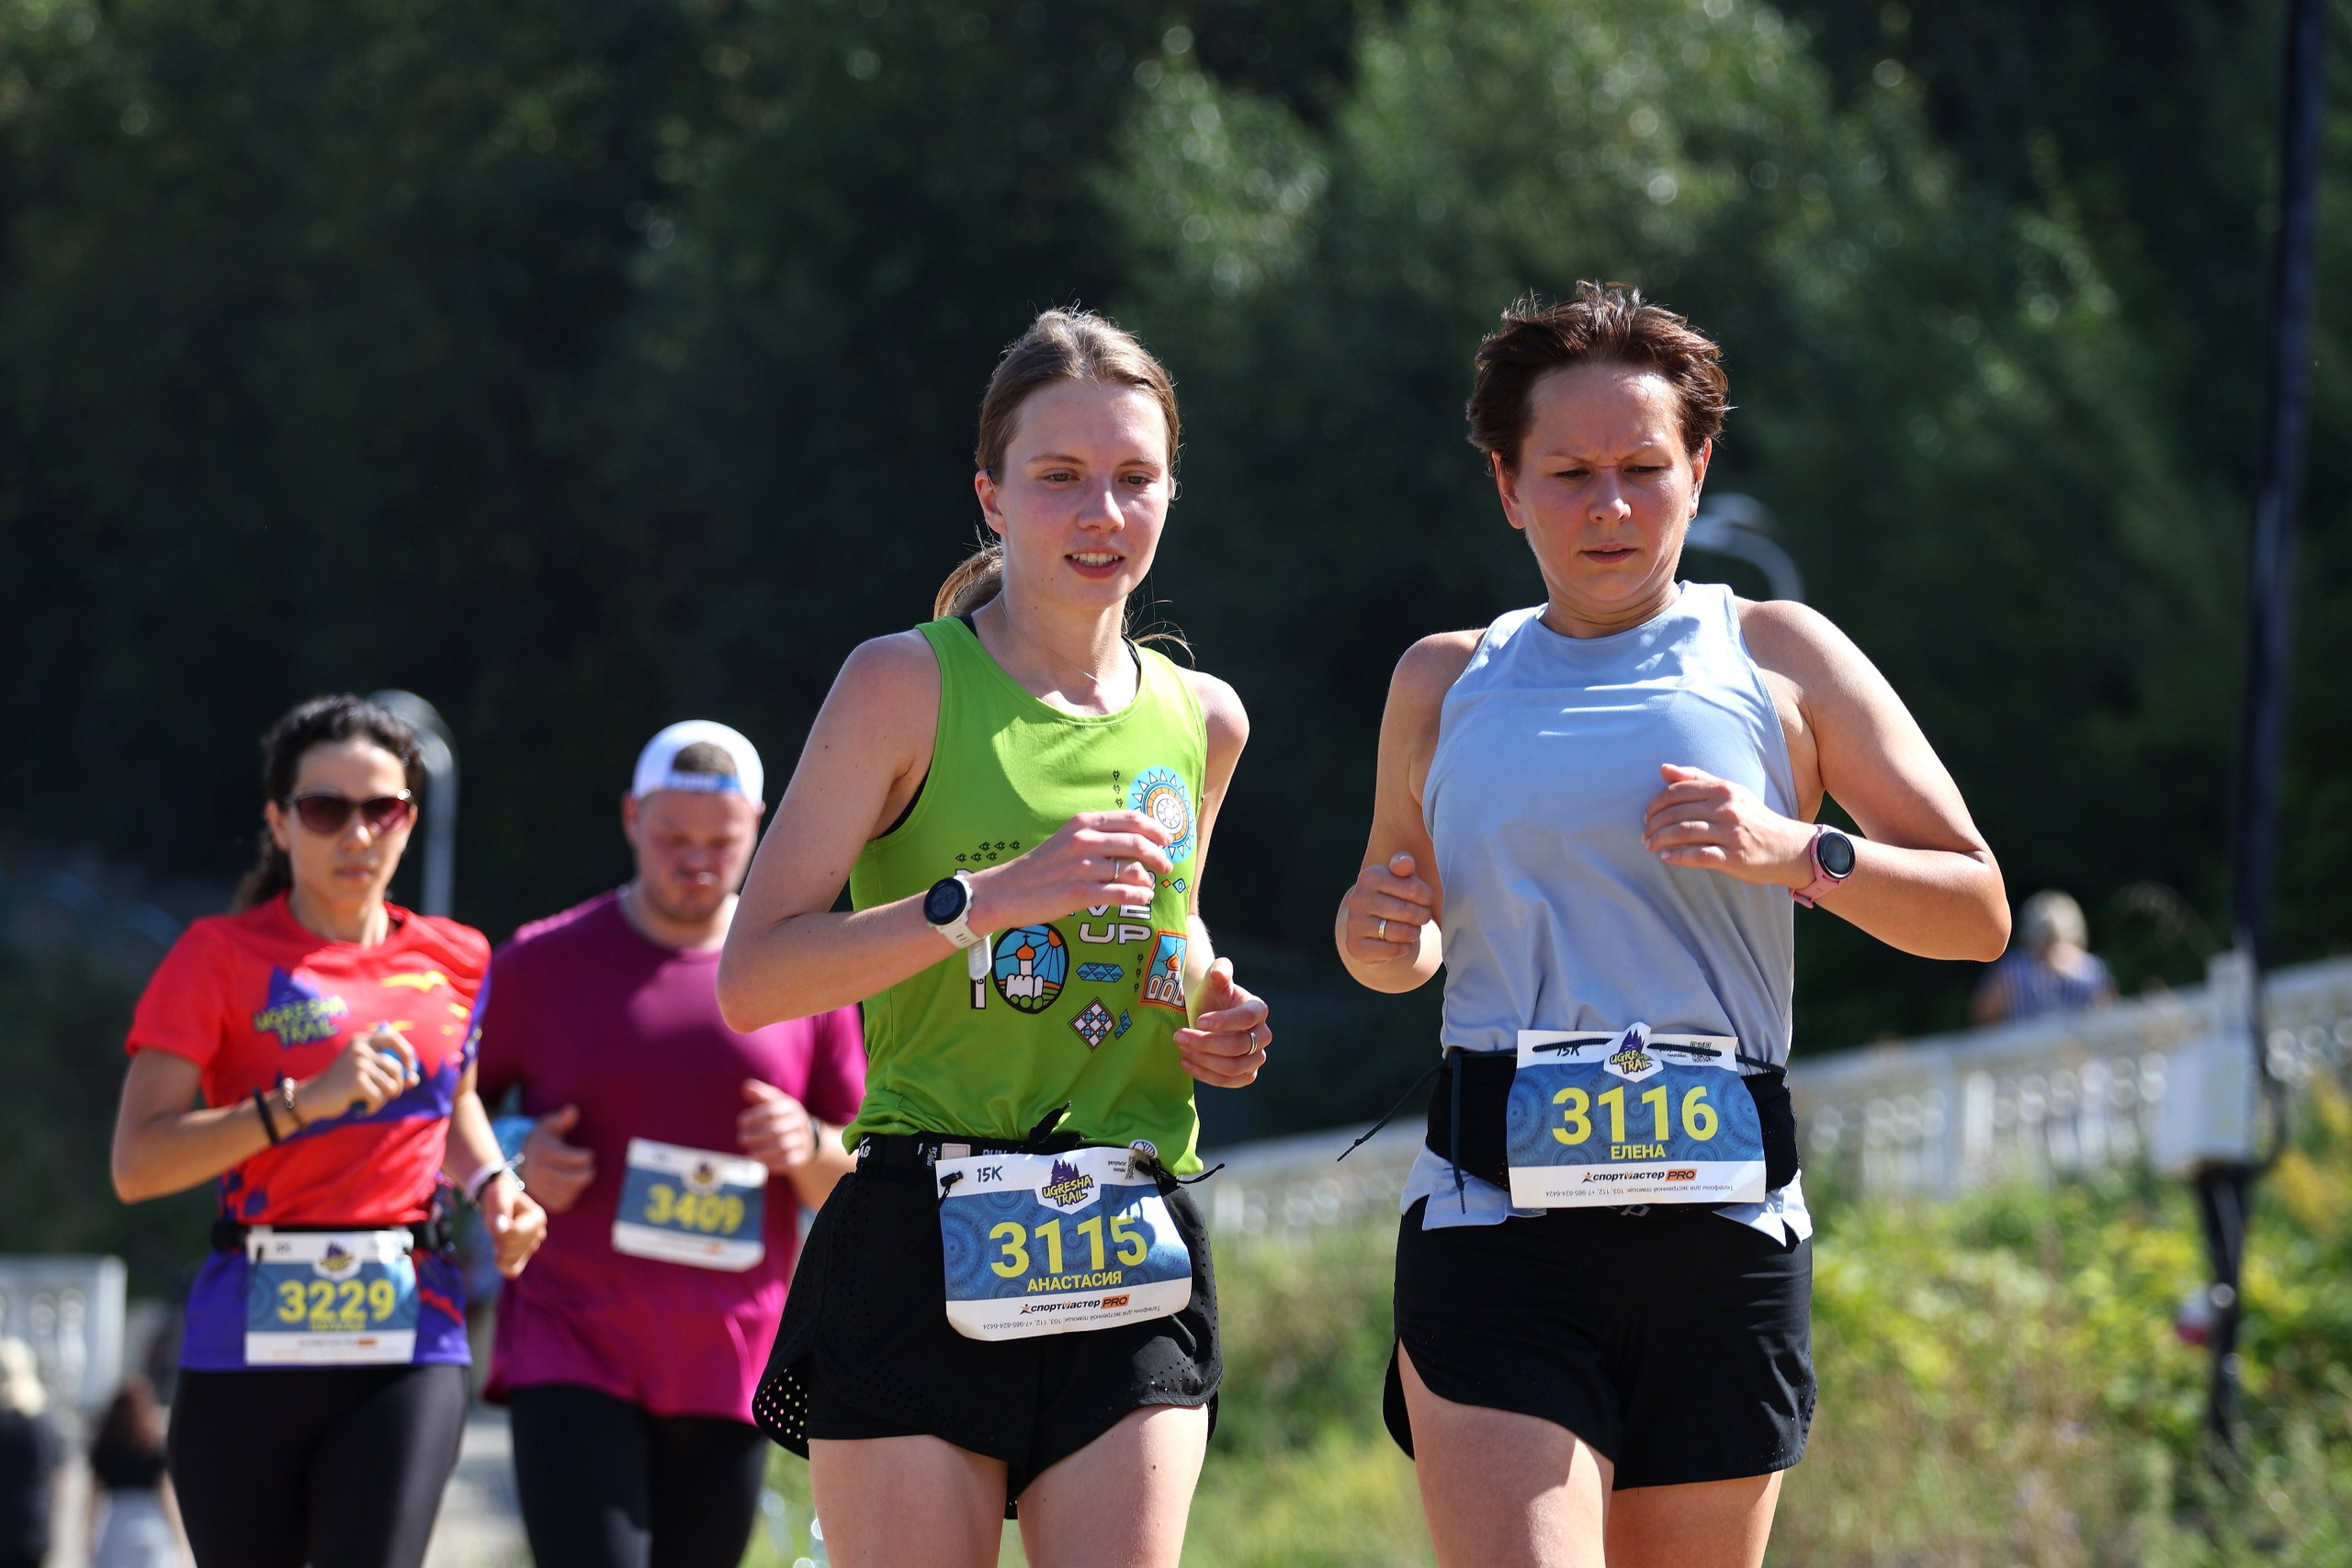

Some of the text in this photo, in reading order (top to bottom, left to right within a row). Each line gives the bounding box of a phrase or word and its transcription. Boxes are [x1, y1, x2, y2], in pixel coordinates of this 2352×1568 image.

[1078, 922, 1151, 945] UP
[1610, 1049, 1654, 1065] UGRE
[1620, 1060, 1653, 1075] TRAIL
[1552, 1085, 1718, 1146] 3116
[1611, 1144, 1666, 1160] ЕЛЕНА
[977, 1166, 1002, 1182] 15K
[1667, 1170, 1695, 1180] PRO
[1042, 1174, 1094, 1198] UGRESHA
[1054, 1190, 1089, 1207] TRAIL
[645, 1182, 745, 1235] 3409
[989, 1215, 1148, 1278] 3115
[1026, 1270, 1122, 1292] АНАСТАСИЯ
[278, 1279, 396, 1323] 3229
[1102, 1295, 1128, 1308] PRO
[1133, 1304, 1160, 1314] Телефоны
[1090, 1312, 1121, 1322] экстренной
